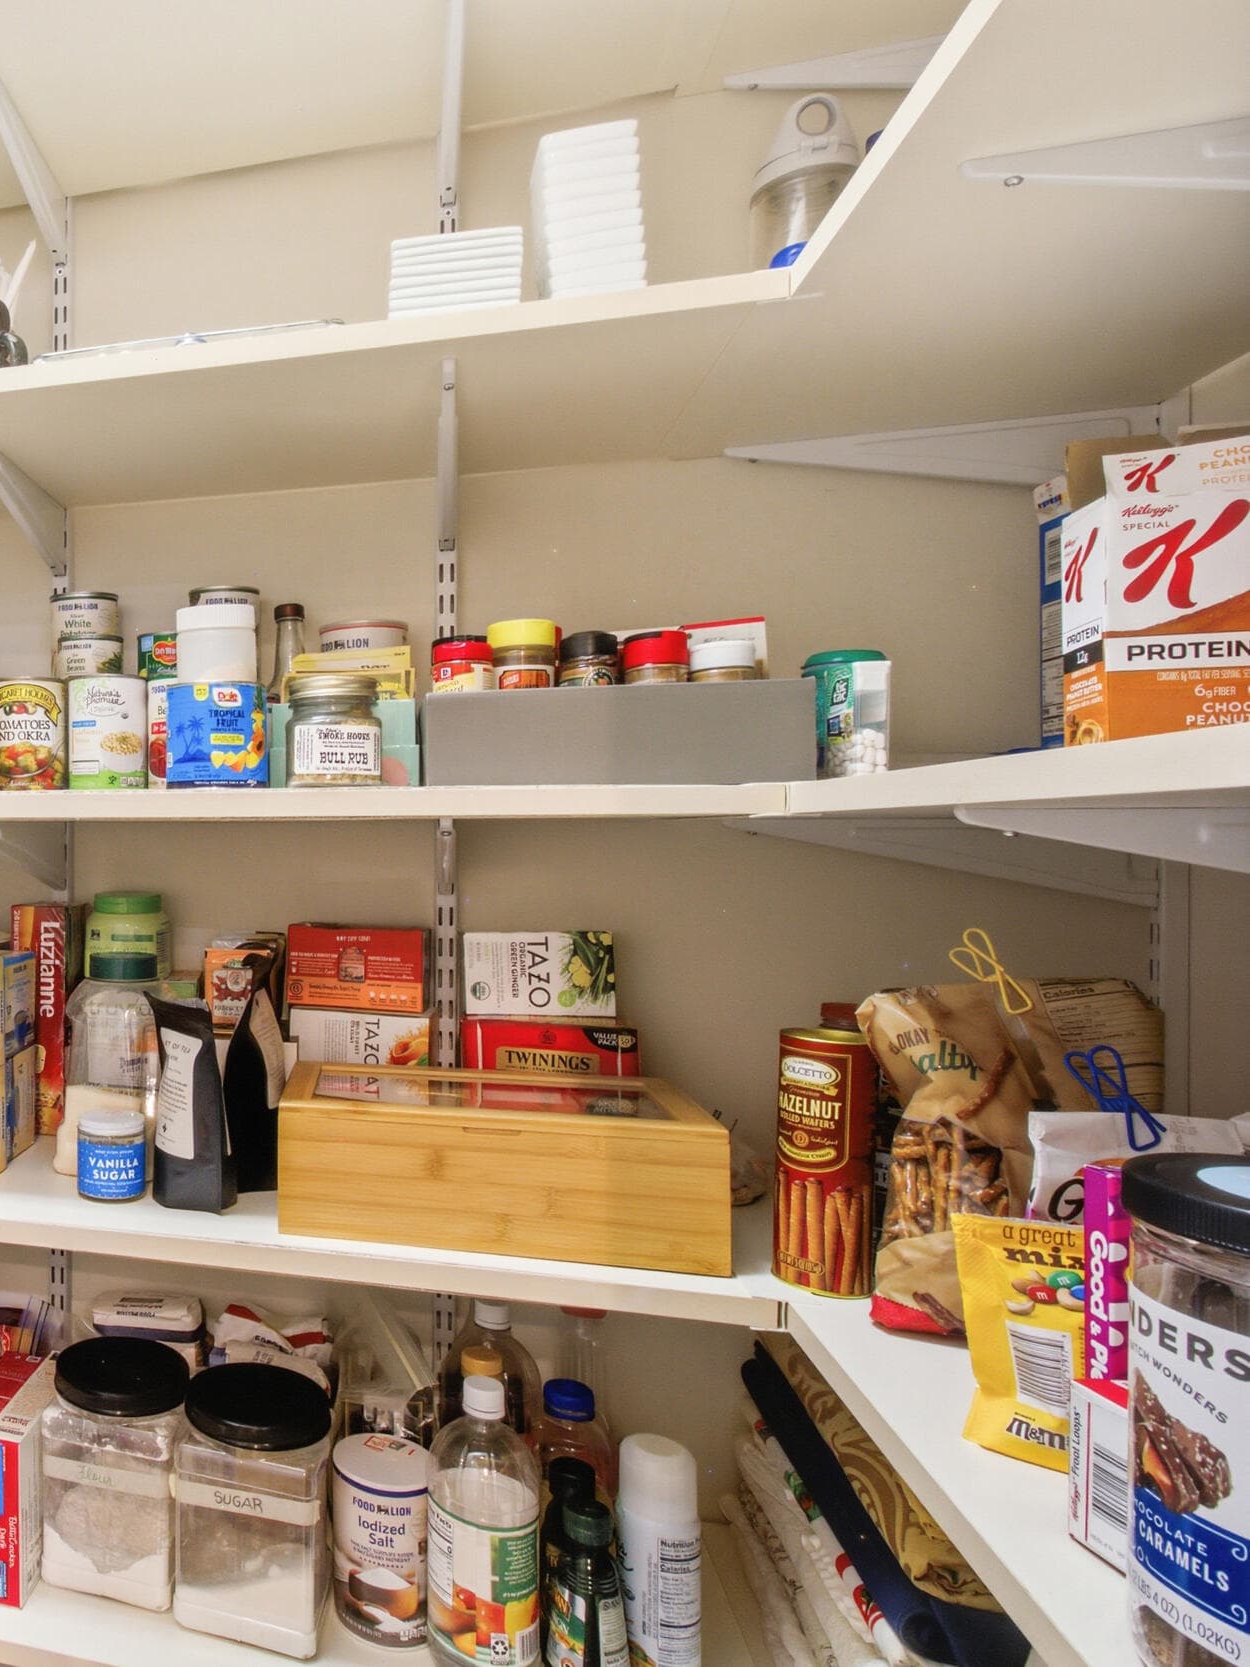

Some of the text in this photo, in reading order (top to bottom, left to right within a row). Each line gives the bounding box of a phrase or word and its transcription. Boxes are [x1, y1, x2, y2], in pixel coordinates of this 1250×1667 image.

[1199, 456, 1250, 470] PEAN
[1124, 454, 1176, 493] K
[1121, 504, 1174, 517] Kellogg's
[1123, 522, 1170, 531] SPECIAL
[1122, 499, 1250, 608] K
[1064, 527, 1099, 603] K
[64, 620, 92, 628] White
[347, 638, 369, 648] LION
[1067, 624, 1099, 647] PROTEIN
[1127, 641, 1250, 661] PROTEIN
[217, 691, 238, 702] Dole
[1194, 683, 1236, 699] 6g FIBER
[209, 709, 244, 718] TROPICAL
[216, 718, 239, 728] FRUIT
[17, 730, 50, 742] OKRA
[320, 752, 369, 764] BULL RUB
[40, 921, 60, 1018] Luzianne
[510, 941, 519, 998] GREEN GINGER
[519, 941, 527, 978] ORGANIC
[527, 936, 550, 1007] TAZO
[1042, 986, 1095, 999] Calories
[593, 1032, 618, 1040] VALUE
[597, 1038, 618, 1046] PACK
[897, 1027, 931, 1050] OKAY
[505, 1050, 589, 1070] TWININGS
[910, 1040, 978, 1081] alty
[784, 1062, 832, 1080] DOLCETTO
[779, 1091, 842, 1120] HAZELNUT
[802, 1116, 835, 1130] WAFERS
[89, 1156, 139, 1168] VANILLA
[93, 1169, 135, 1180] SUGAR
[1003, 1224, 1076, 1248] a great
[1003, 1246, 1085, 1271] mix
[1057, 1276, 1070, 1286] m
[1090, 1230, 1109, 1336] Good &
[1036, 1290, 1049, 1300] m
[1131, 1300, 1250, 1382] DERS
[1153, 1358, 1228, 1424] WONDERS
[1071, 1410, 1081, 1447] Loops
[1071, 1447, 1081, 1476] Froot
[214, 1490, 263, 1513] SUGAR
[352, 1496, 412, 1516] FOOD LION
[358, 1516, 405, 1535] Iodized
[1135, 1499, 1208, 1557] OCOLATE
[368, 1533, 394, 1549] Salt
[660, 1540, 695, 1549] Nutrition
[1139, 1519, 1230, 1592] CARAMELS
[660, 1564, 691, 1573] Calories
[1152, 1592, 1159, 1605] 4
[1182, 1613, 1241, 1660] (1.02KG)
